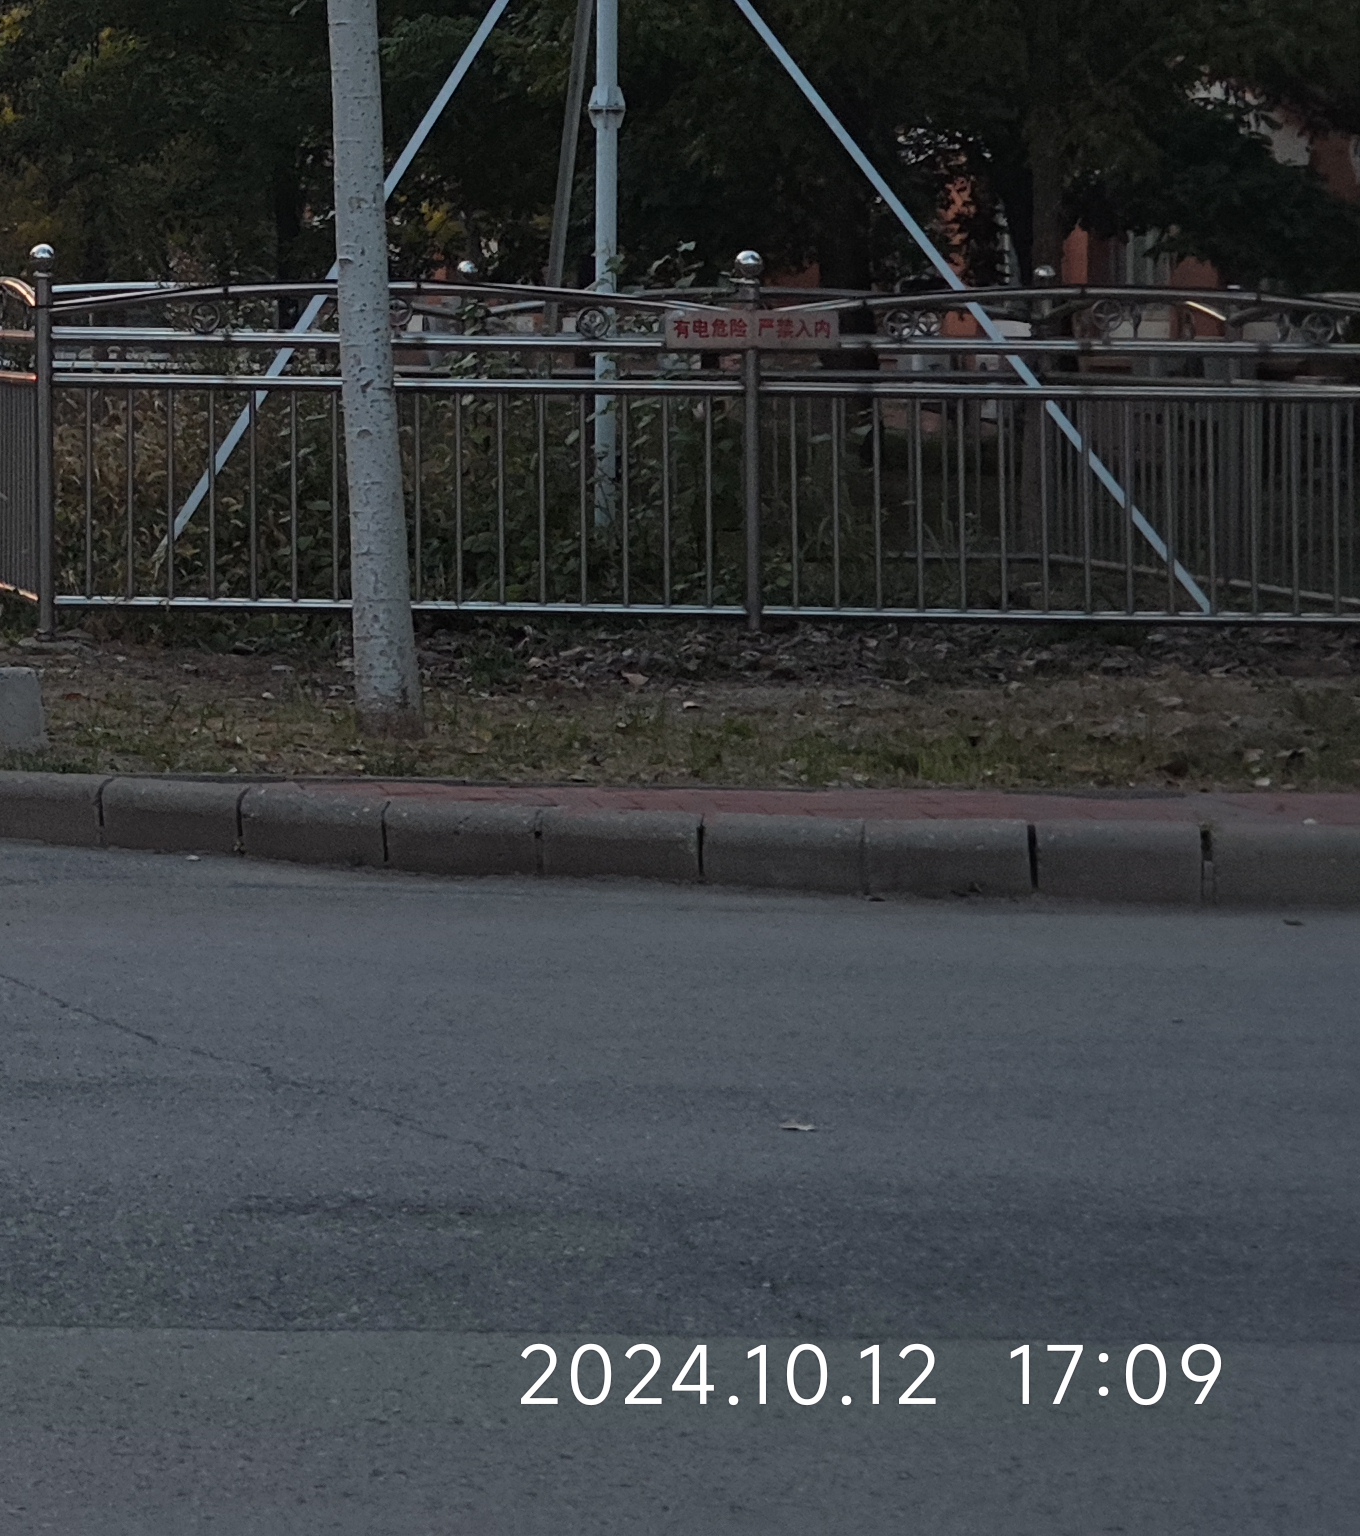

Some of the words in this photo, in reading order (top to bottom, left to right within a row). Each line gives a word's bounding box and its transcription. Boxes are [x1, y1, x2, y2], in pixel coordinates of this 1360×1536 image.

[674, 318, 748, 338] 有电危险
[758, 318, 831, 338] 严禁入内
